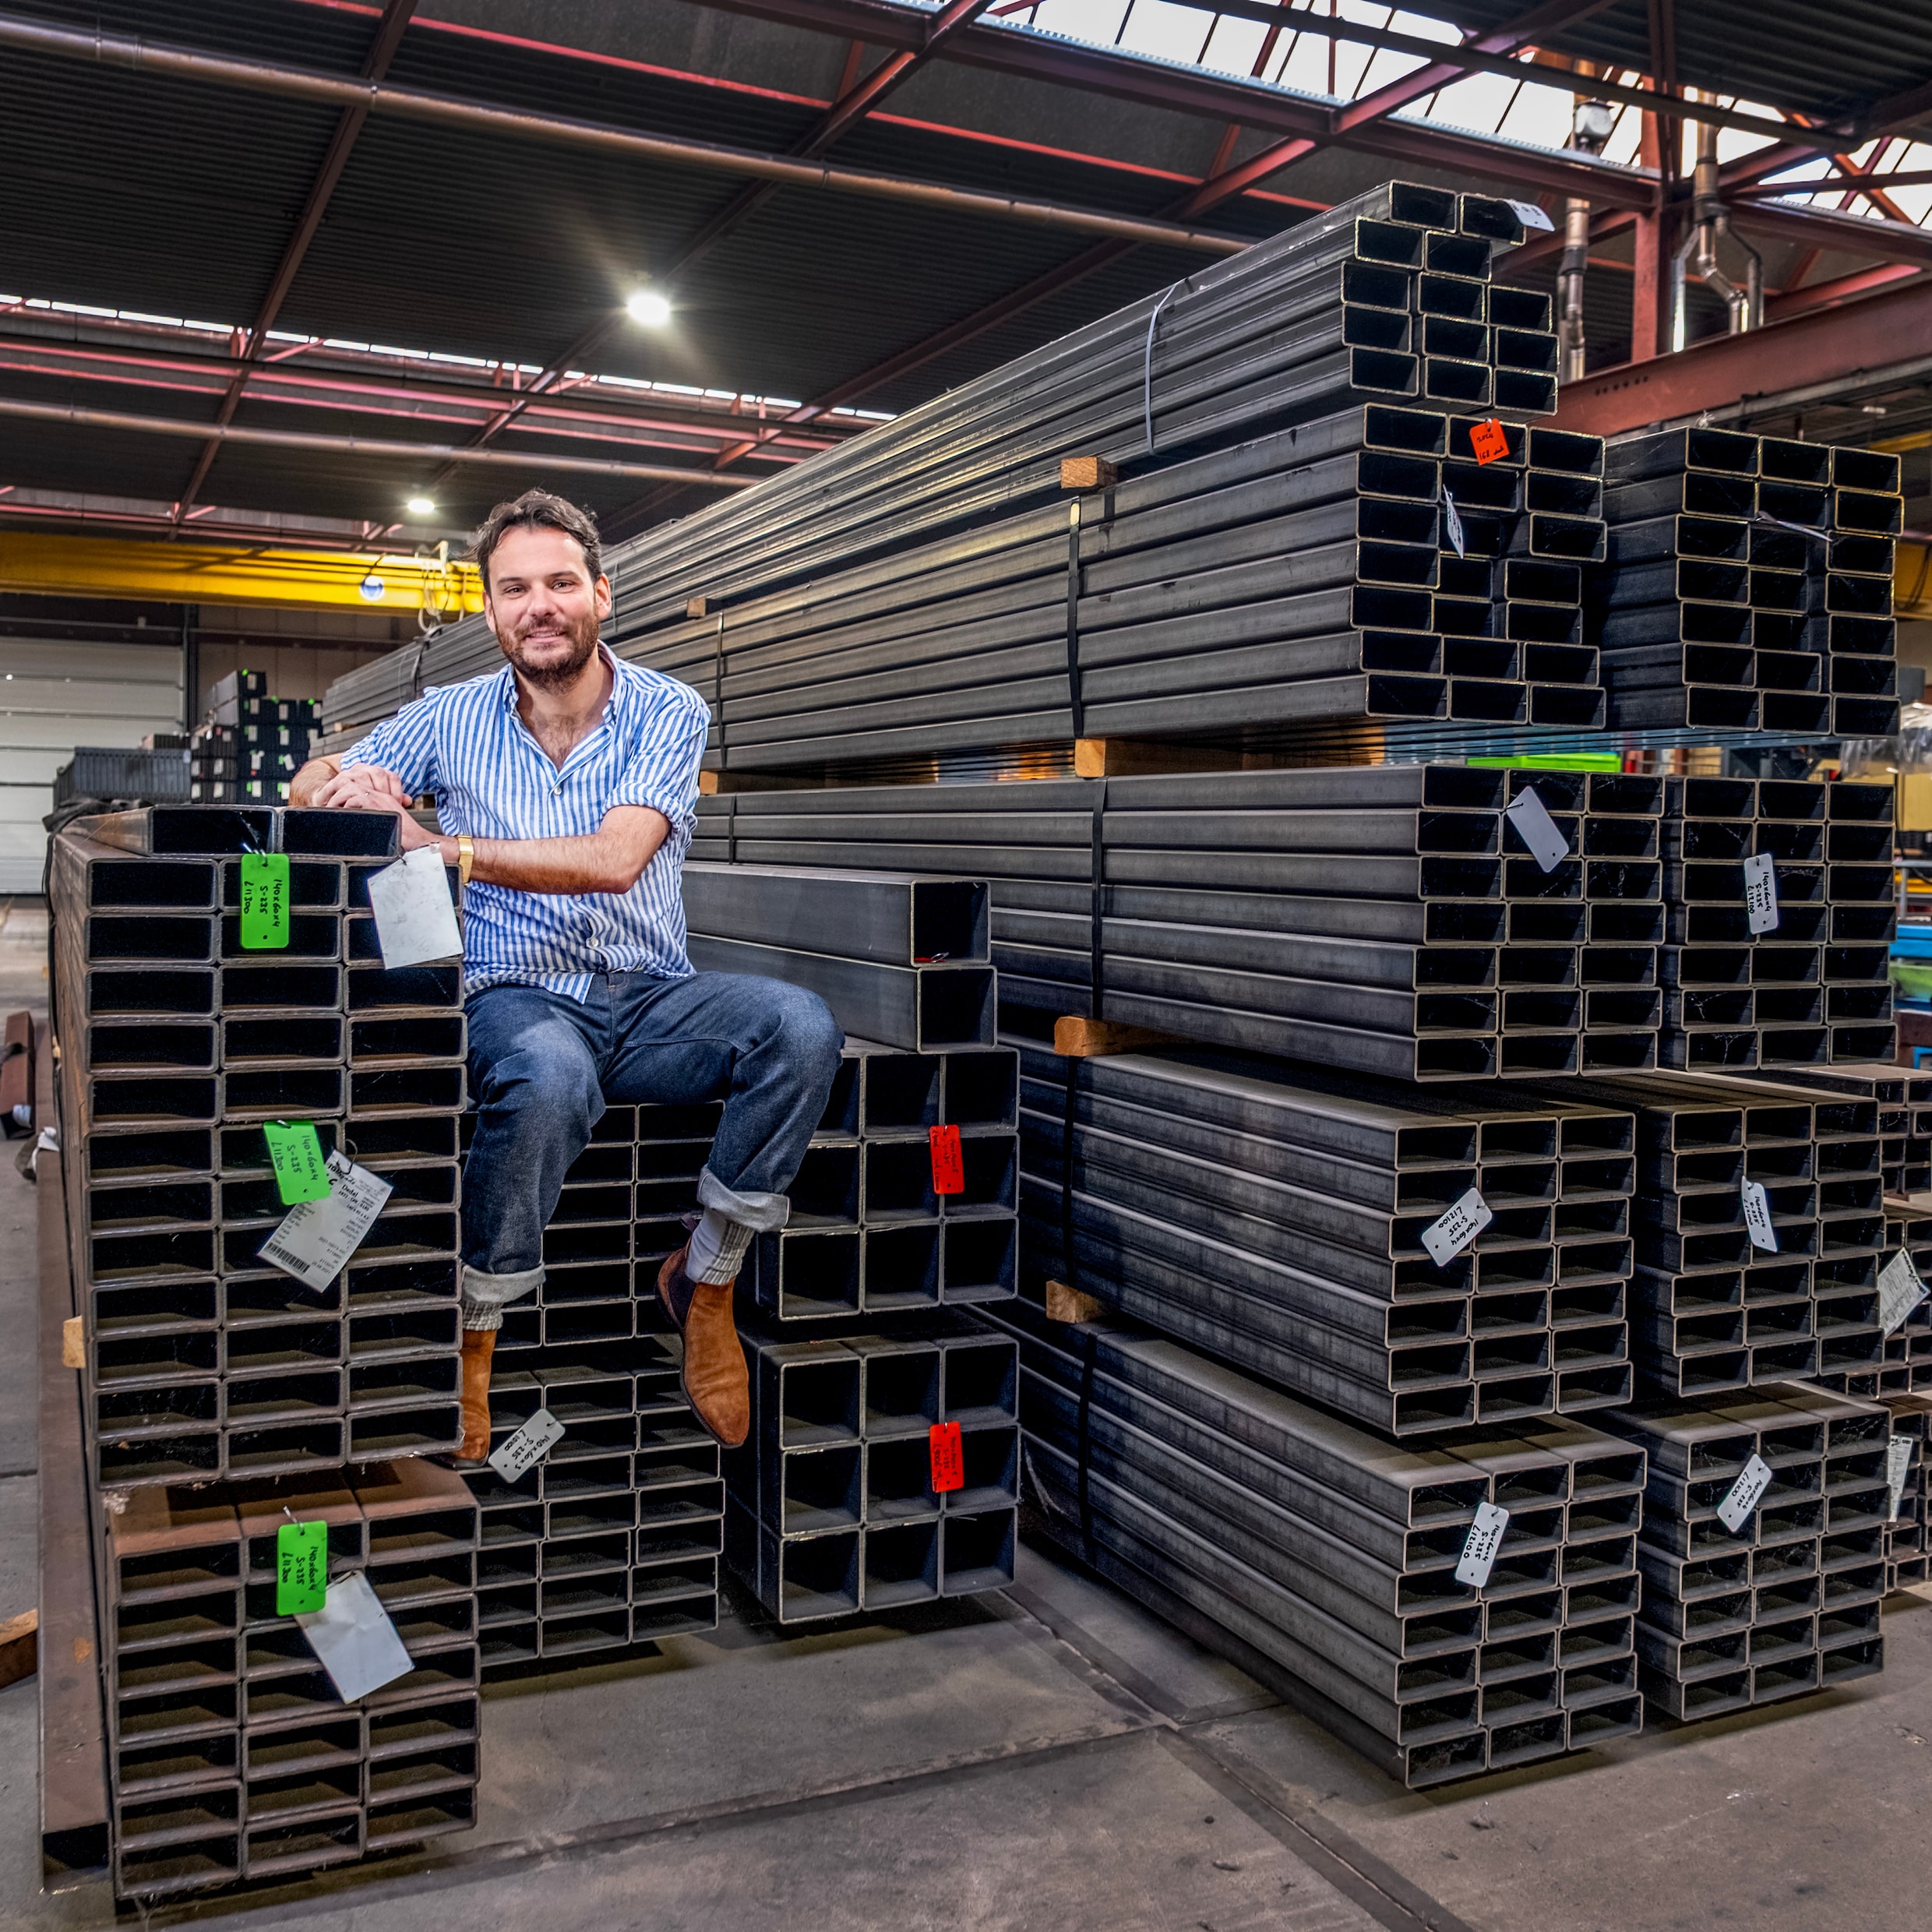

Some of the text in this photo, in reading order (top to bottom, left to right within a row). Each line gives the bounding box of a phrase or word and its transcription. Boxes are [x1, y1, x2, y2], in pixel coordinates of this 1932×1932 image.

[259, 886, 268, 915] S-235
[273, 879, 282, 927] 140x60x4
[287, 1144, 301, 1173] S-235
[301, 1135, 318, 1180] 140x60x4
[1449, 1215, 1468, 1237] S-235
[512, 1437, 534, 1460] S-235
[1475, 1532, 1489, 1560] S-235
[296, 1557, 305, 1585] S-235
